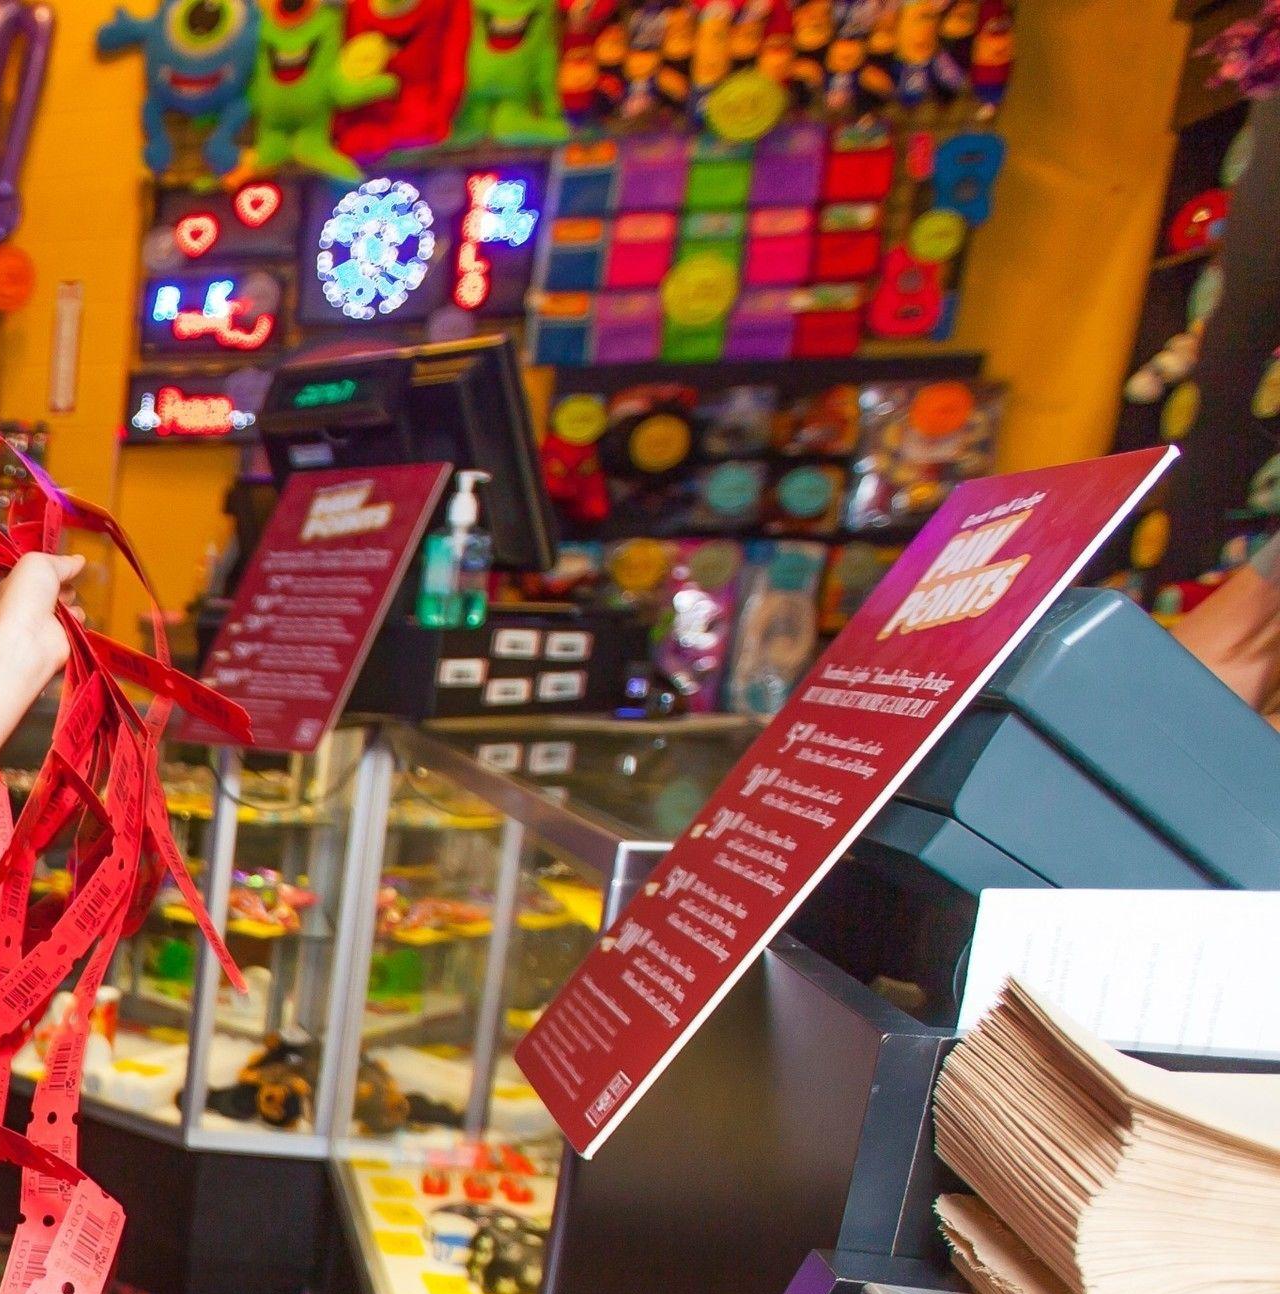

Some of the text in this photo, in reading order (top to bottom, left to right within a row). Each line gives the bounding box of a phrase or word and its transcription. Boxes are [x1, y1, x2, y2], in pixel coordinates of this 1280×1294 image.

[922, 523, 1013, 584] PAW
[881, 562, 1025, 637] POINTS
[60, 1194, 88, 1250] LODGE
[105, 1210, 120, 1242] GREAT
